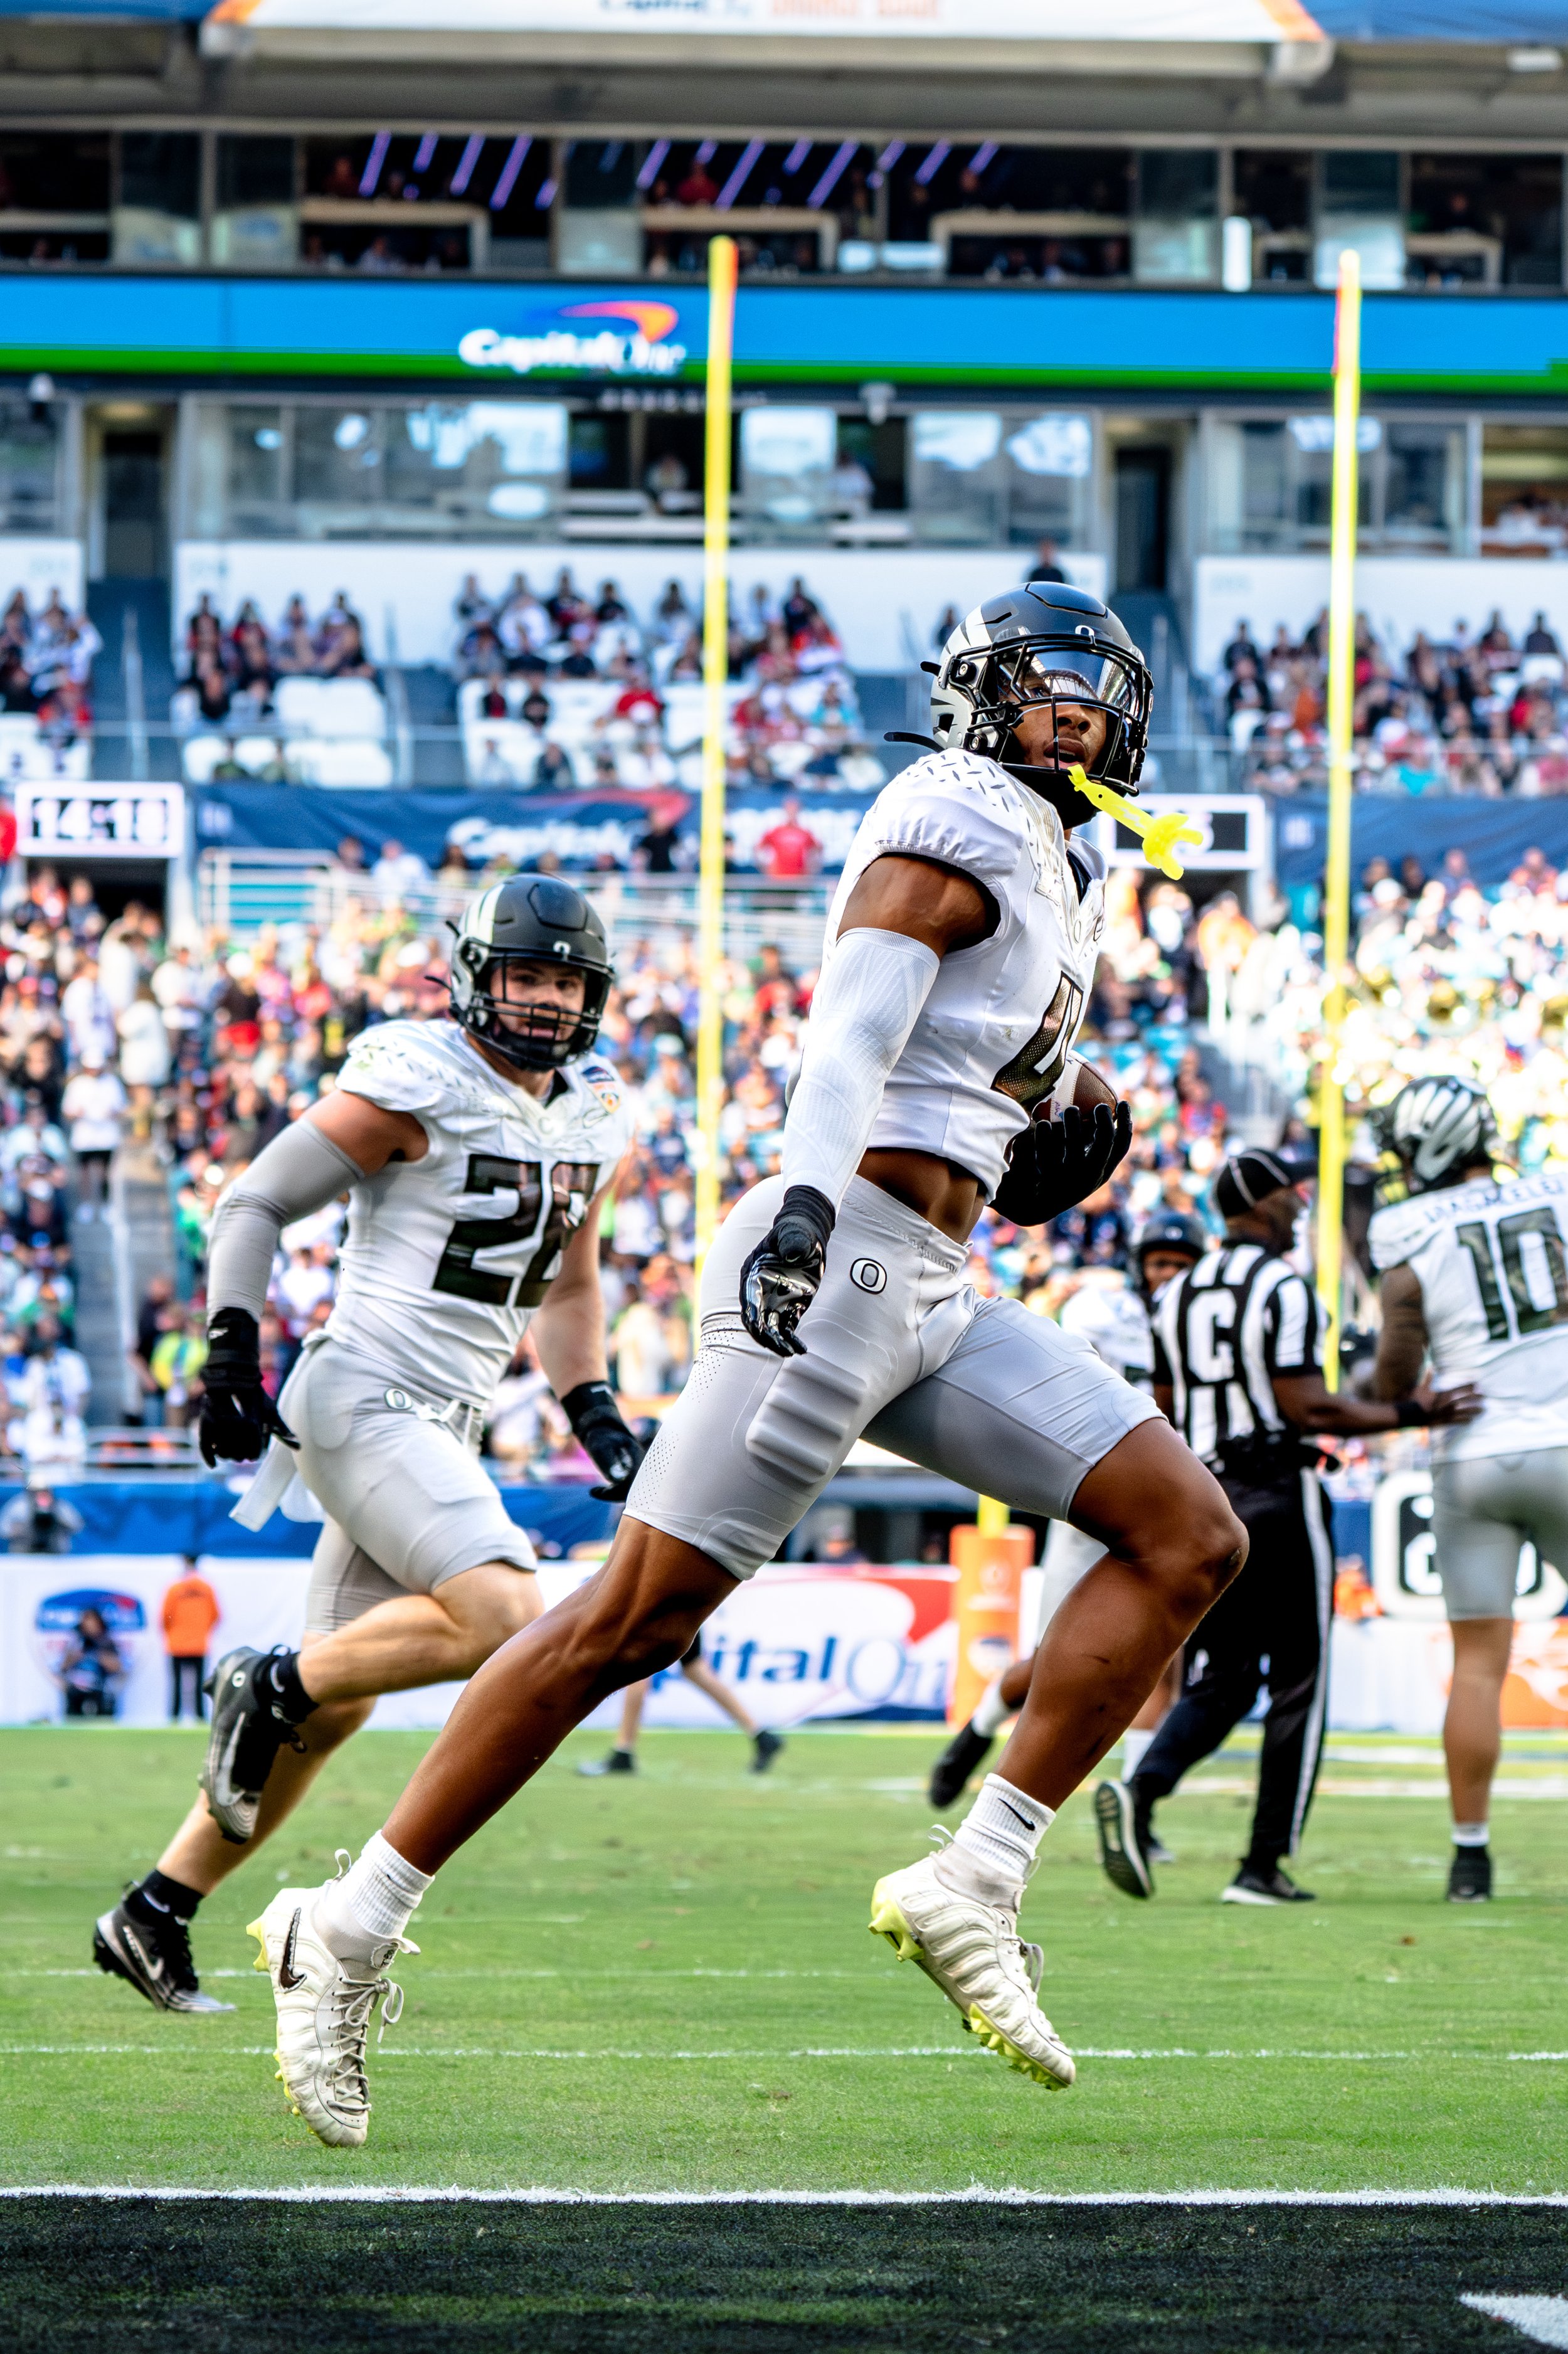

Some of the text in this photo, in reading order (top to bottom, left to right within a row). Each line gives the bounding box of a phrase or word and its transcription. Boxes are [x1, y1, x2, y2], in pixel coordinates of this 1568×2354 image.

[850, 1258, 887, 1295] O
[1456, 1207, 1568, 1341] 10
[1186, 1288, 1237, 1383] C
